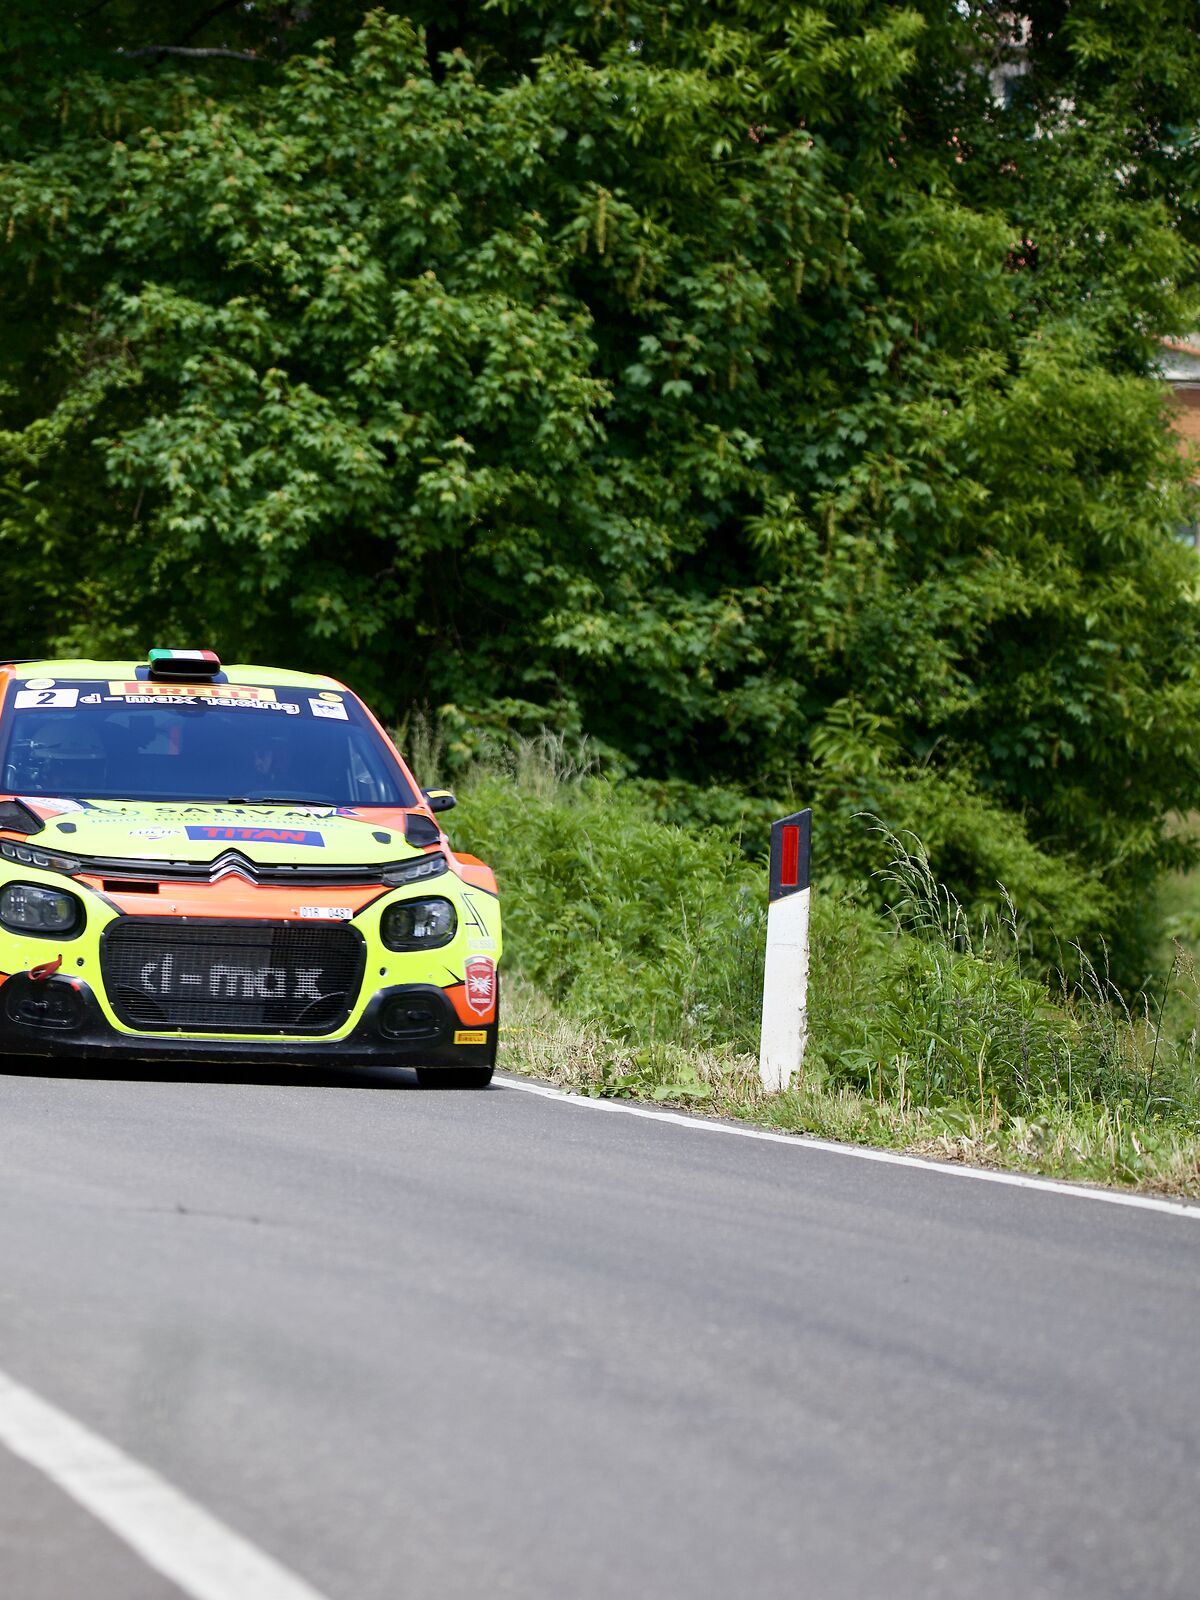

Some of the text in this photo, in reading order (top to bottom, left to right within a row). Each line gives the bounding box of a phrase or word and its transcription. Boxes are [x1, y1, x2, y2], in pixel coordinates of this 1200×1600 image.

[36, 692, 56, 704] 2
[124, 682, 259, 699] PIRELLI
[80, 693, 198, 705] d-max
[200, 697, 299, 714] racing
[202, 827, 305, 842] TITAN
[140, 953, 324, 999] d-max
